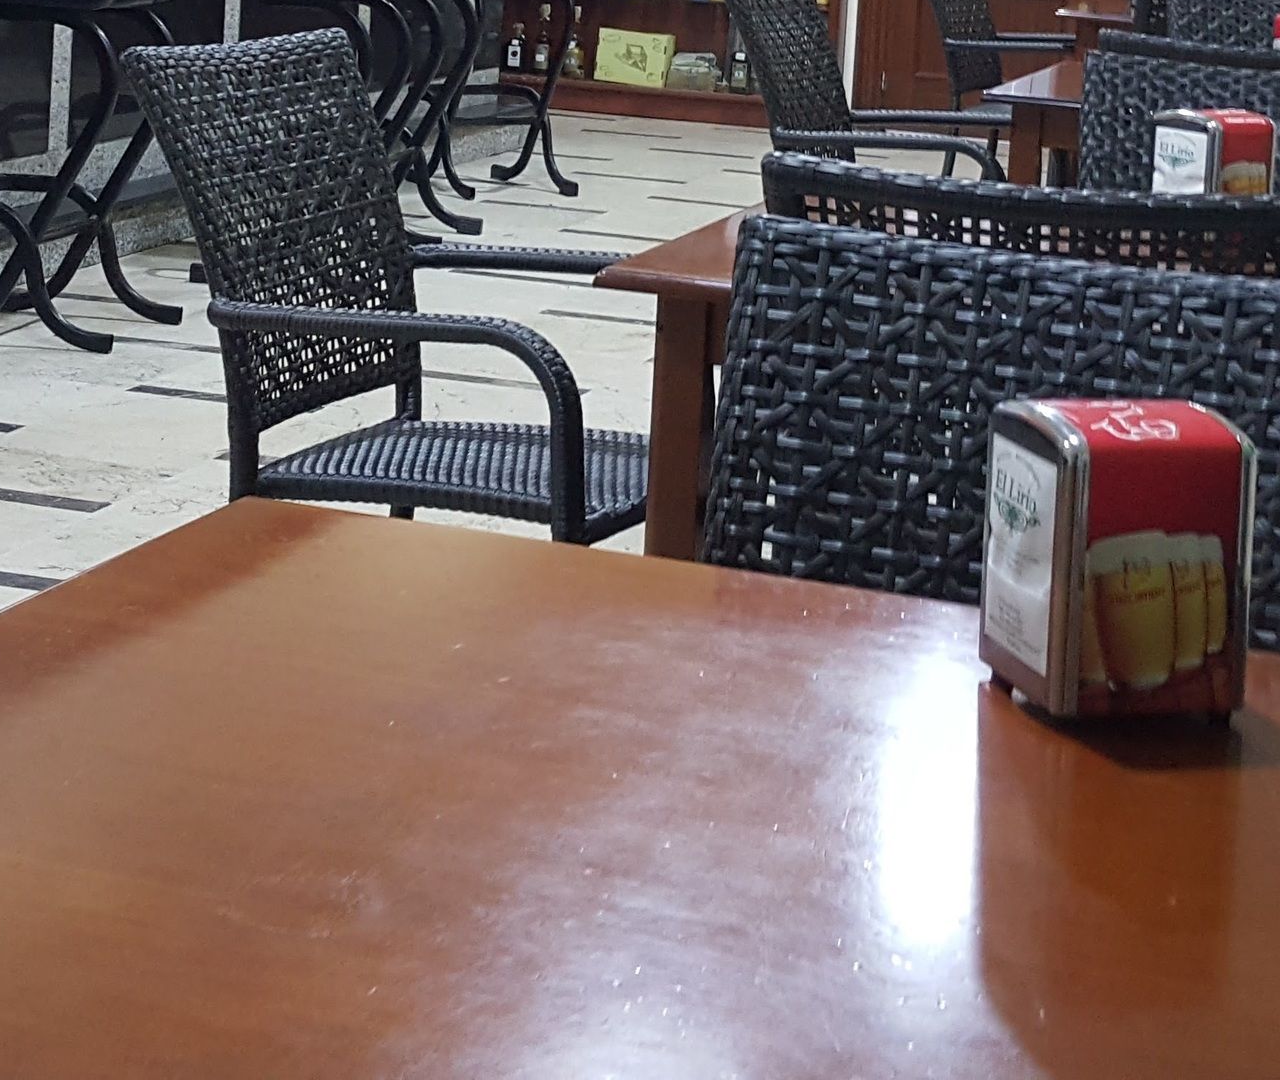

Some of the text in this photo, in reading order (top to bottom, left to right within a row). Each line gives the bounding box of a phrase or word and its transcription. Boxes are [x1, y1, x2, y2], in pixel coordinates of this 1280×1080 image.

[1159, 140, 1195, 157] El Lirio
[995, 468, 1037, 515] El Lirio
